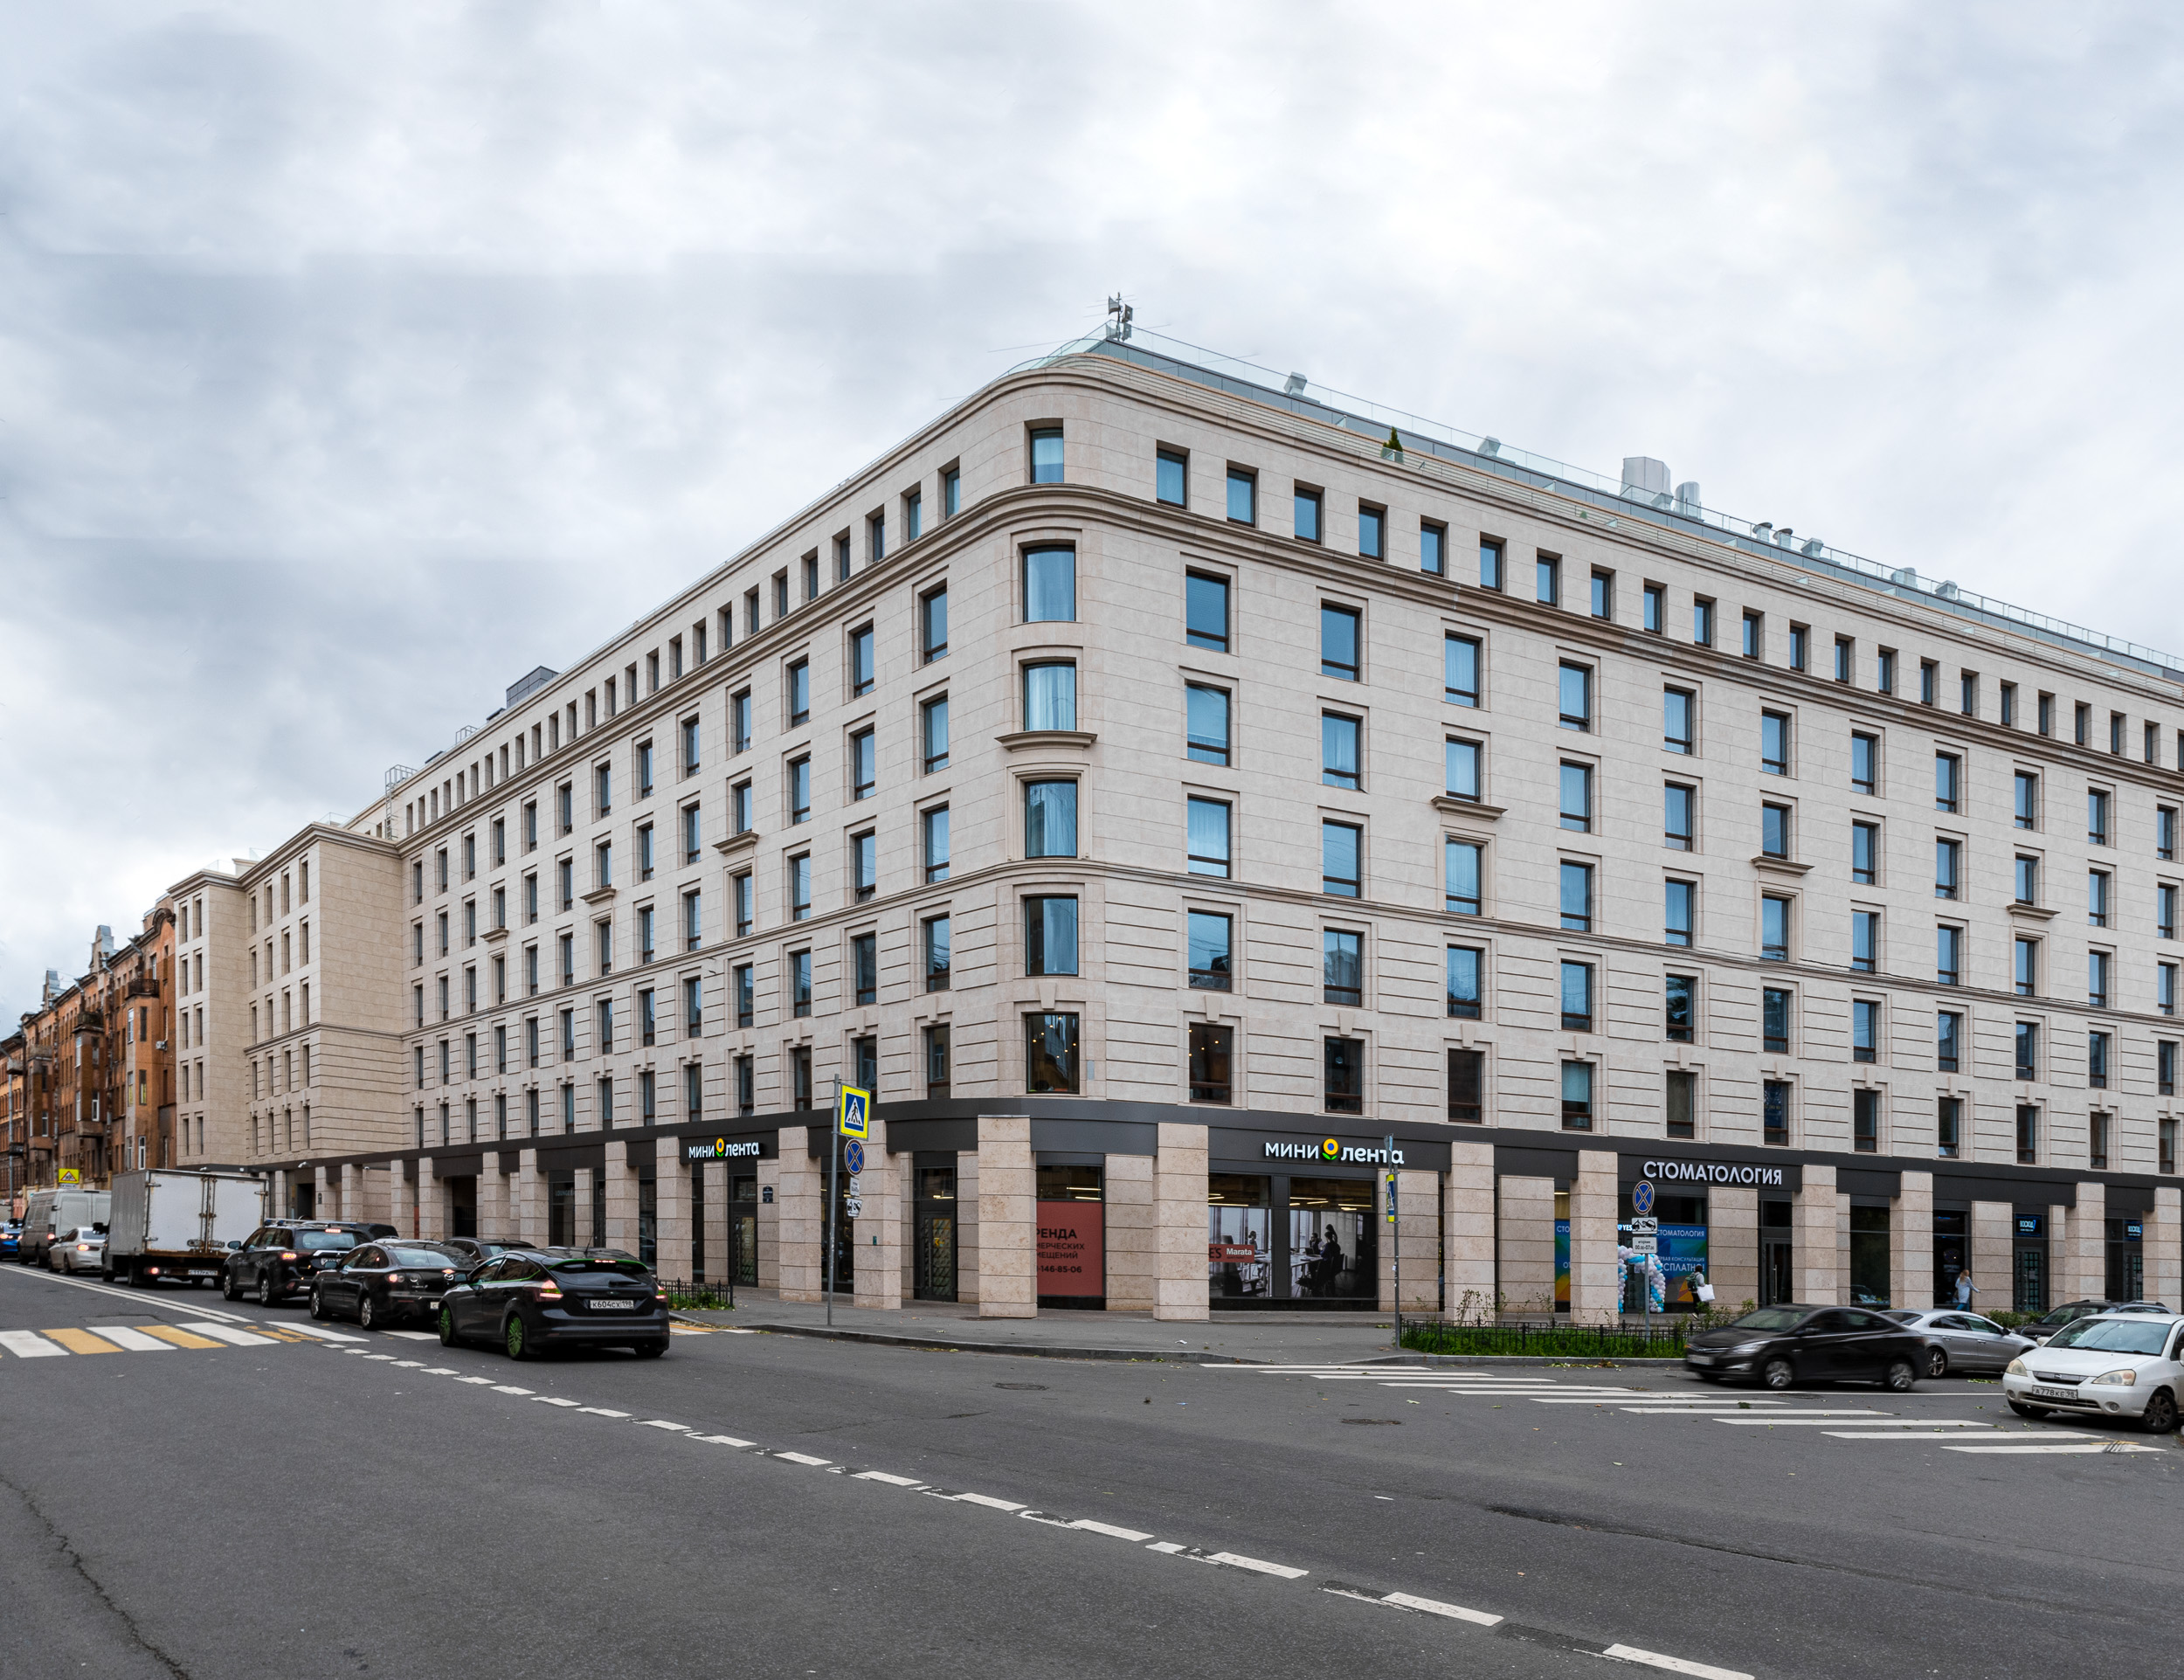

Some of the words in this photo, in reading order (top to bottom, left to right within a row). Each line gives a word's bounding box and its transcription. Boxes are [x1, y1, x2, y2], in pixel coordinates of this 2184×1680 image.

[688, 1144, 715, 1158] мини
[724, 1142, 760, 1158] лента
[1265, 1143, 1319, 1159] мини
[1340, 1146, 1405, 1165] лента
[1643, 1161, 1782, 1185] СТОМАТОЛОГИЯ
